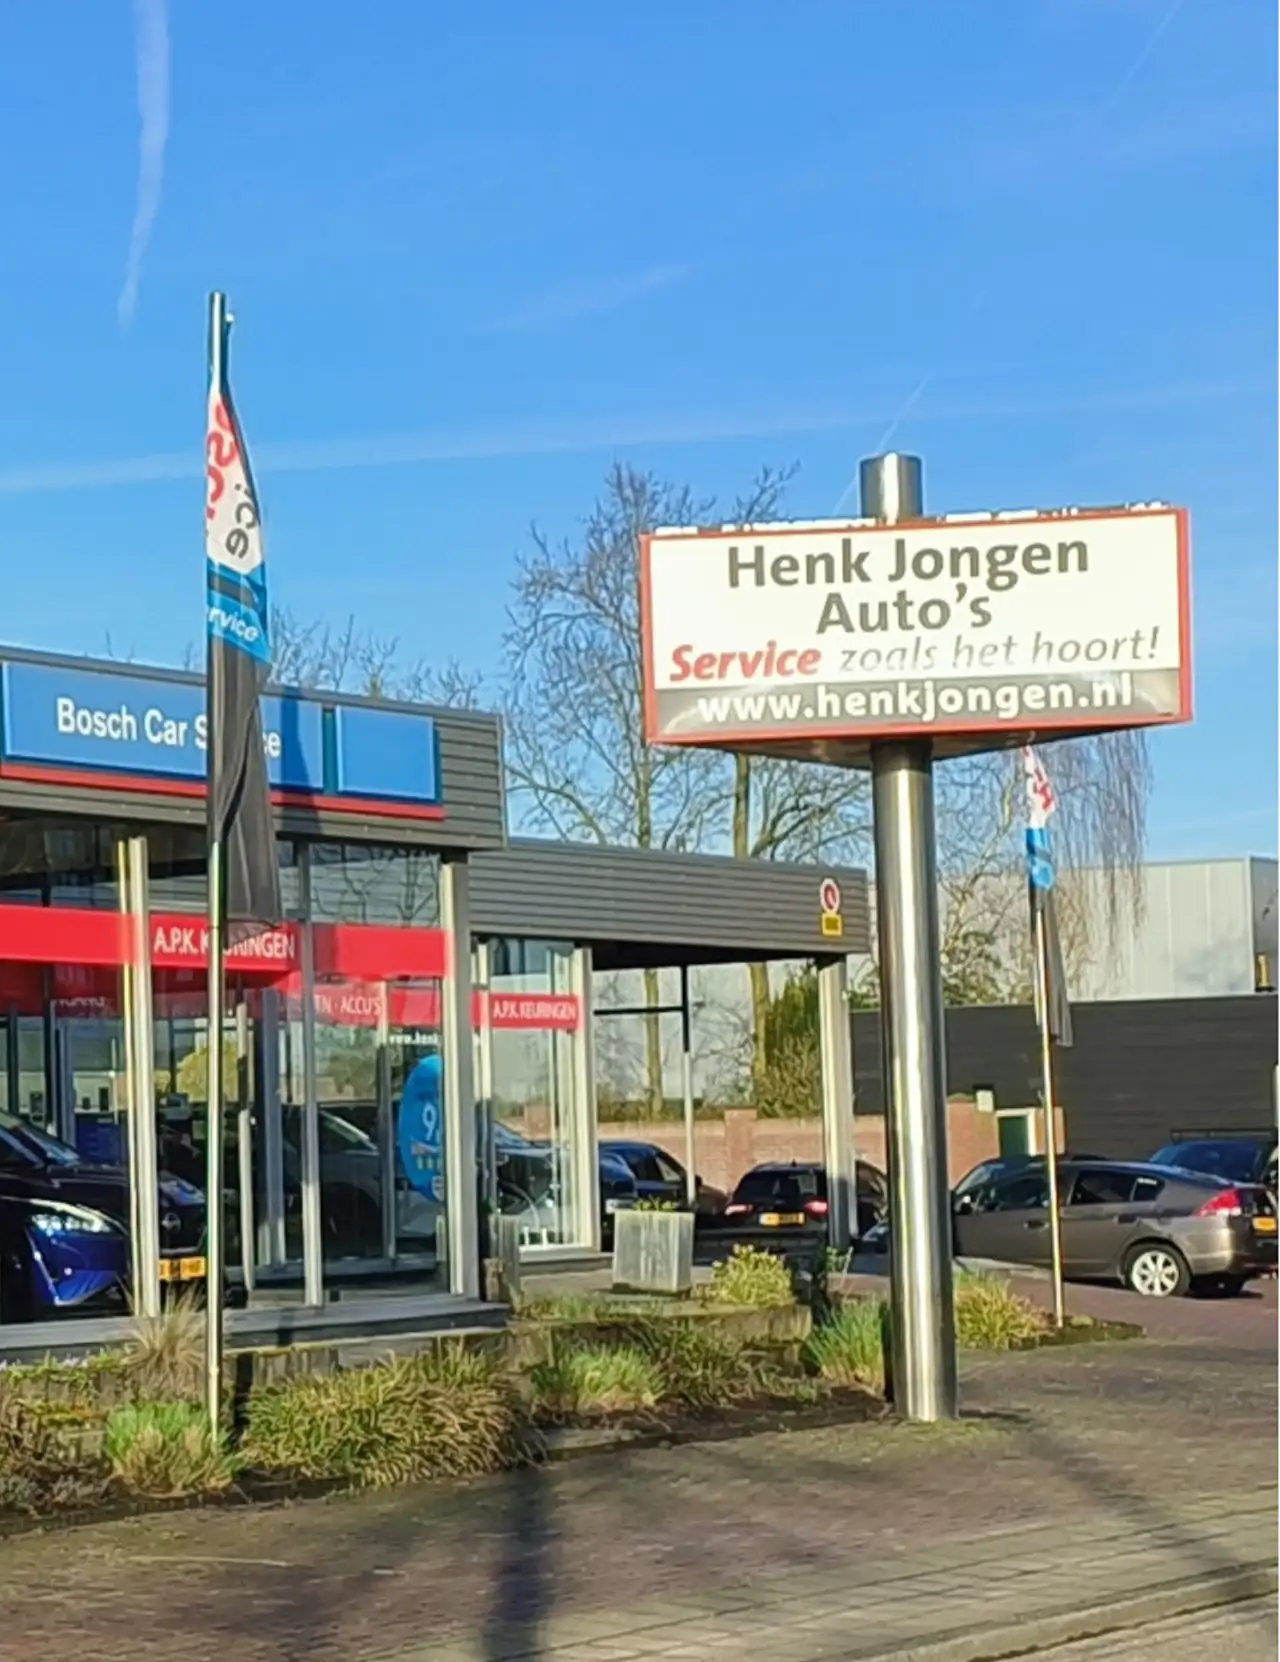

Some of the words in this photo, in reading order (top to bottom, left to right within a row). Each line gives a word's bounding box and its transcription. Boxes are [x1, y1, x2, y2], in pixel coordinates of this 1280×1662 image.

[727, 537, 873, 588] Henk
[887, 536, 1090, 592] Jongen
[207, 606, 259, 642] rvice
[815, 582, 993, 635] Auto's
[669, 640, 822, 682] Service
[839, 636, 938, 672] zoals
[951, 633, 1018, 668] het
[1031, 626, 1160, 665] hoort!
[56, 697, 137, 741] Bosch
[144, 708, 187, 747] Car
[697, 673, 1133, 723] www.henkjongen.nl
